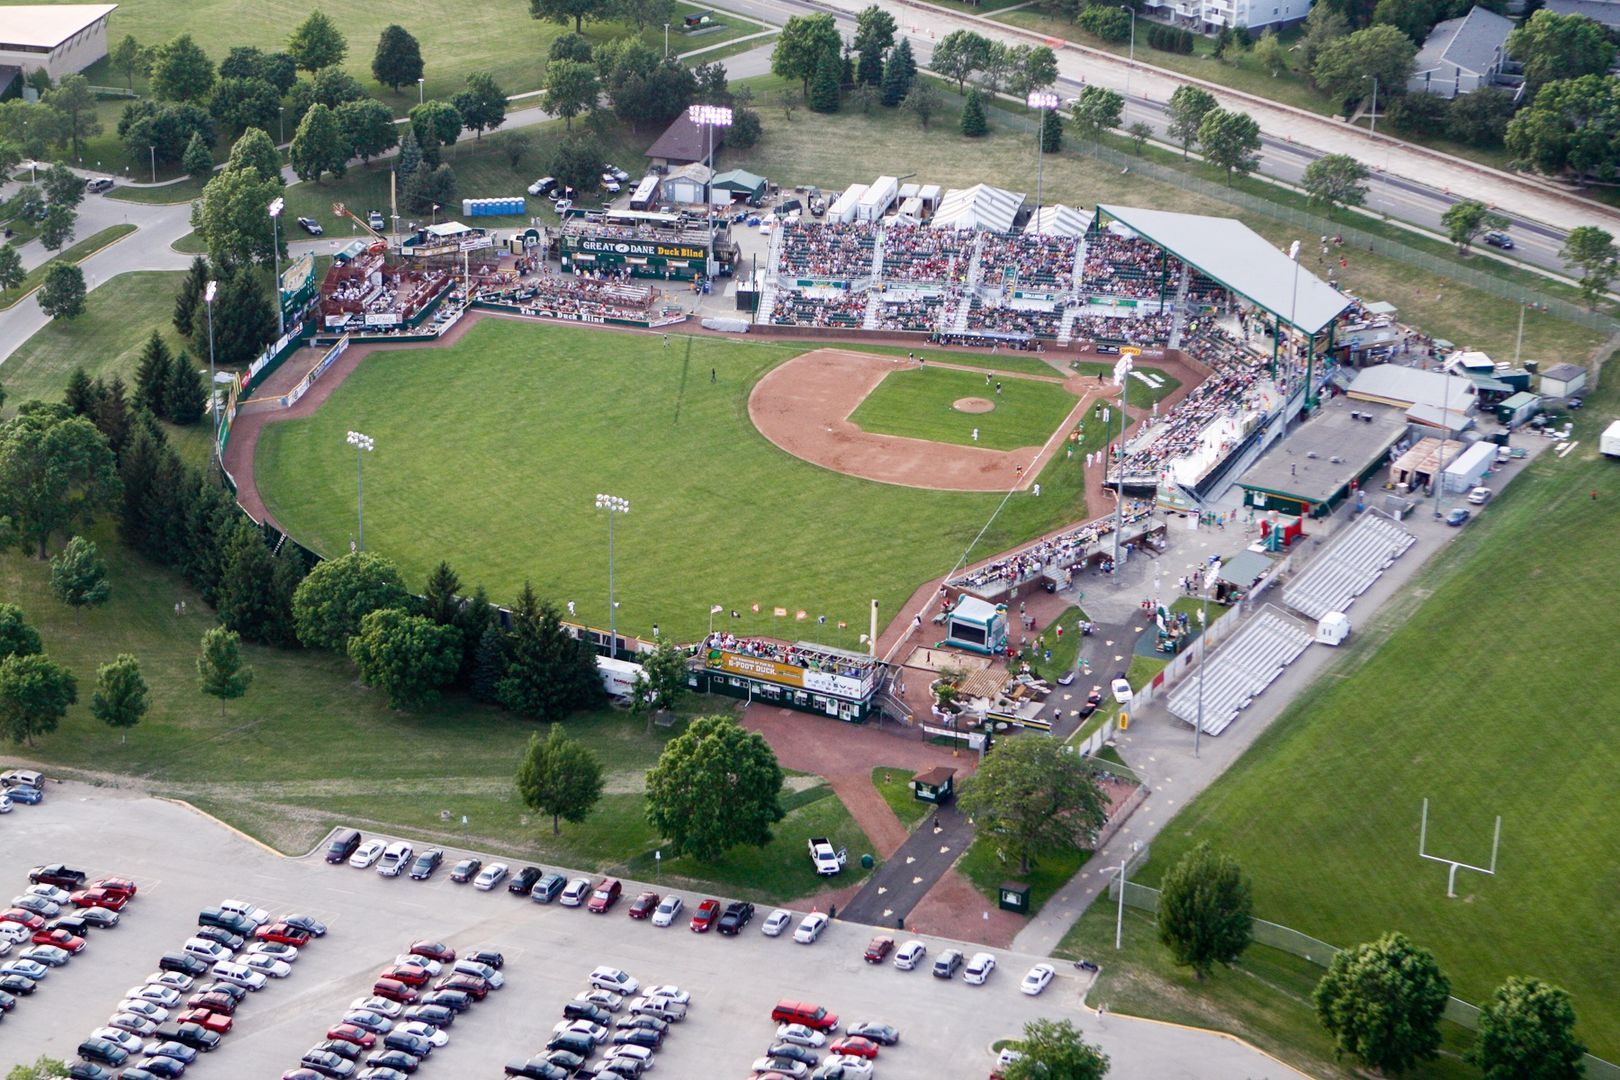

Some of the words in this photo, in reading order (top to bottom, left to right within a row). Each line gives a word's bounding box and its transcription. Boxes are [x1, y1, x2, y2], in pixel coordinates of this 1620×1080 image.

[583, 241, 615, 251] GREAT
[630, 244, 655, 254] DANE
[658, 246, 680, 256] Duck
[681, 248, 704, 258] Blind
[520, 307, 536, 315] The
[557, 312, 578, 320] Duck
[582, 314, 605, 323] Blind
